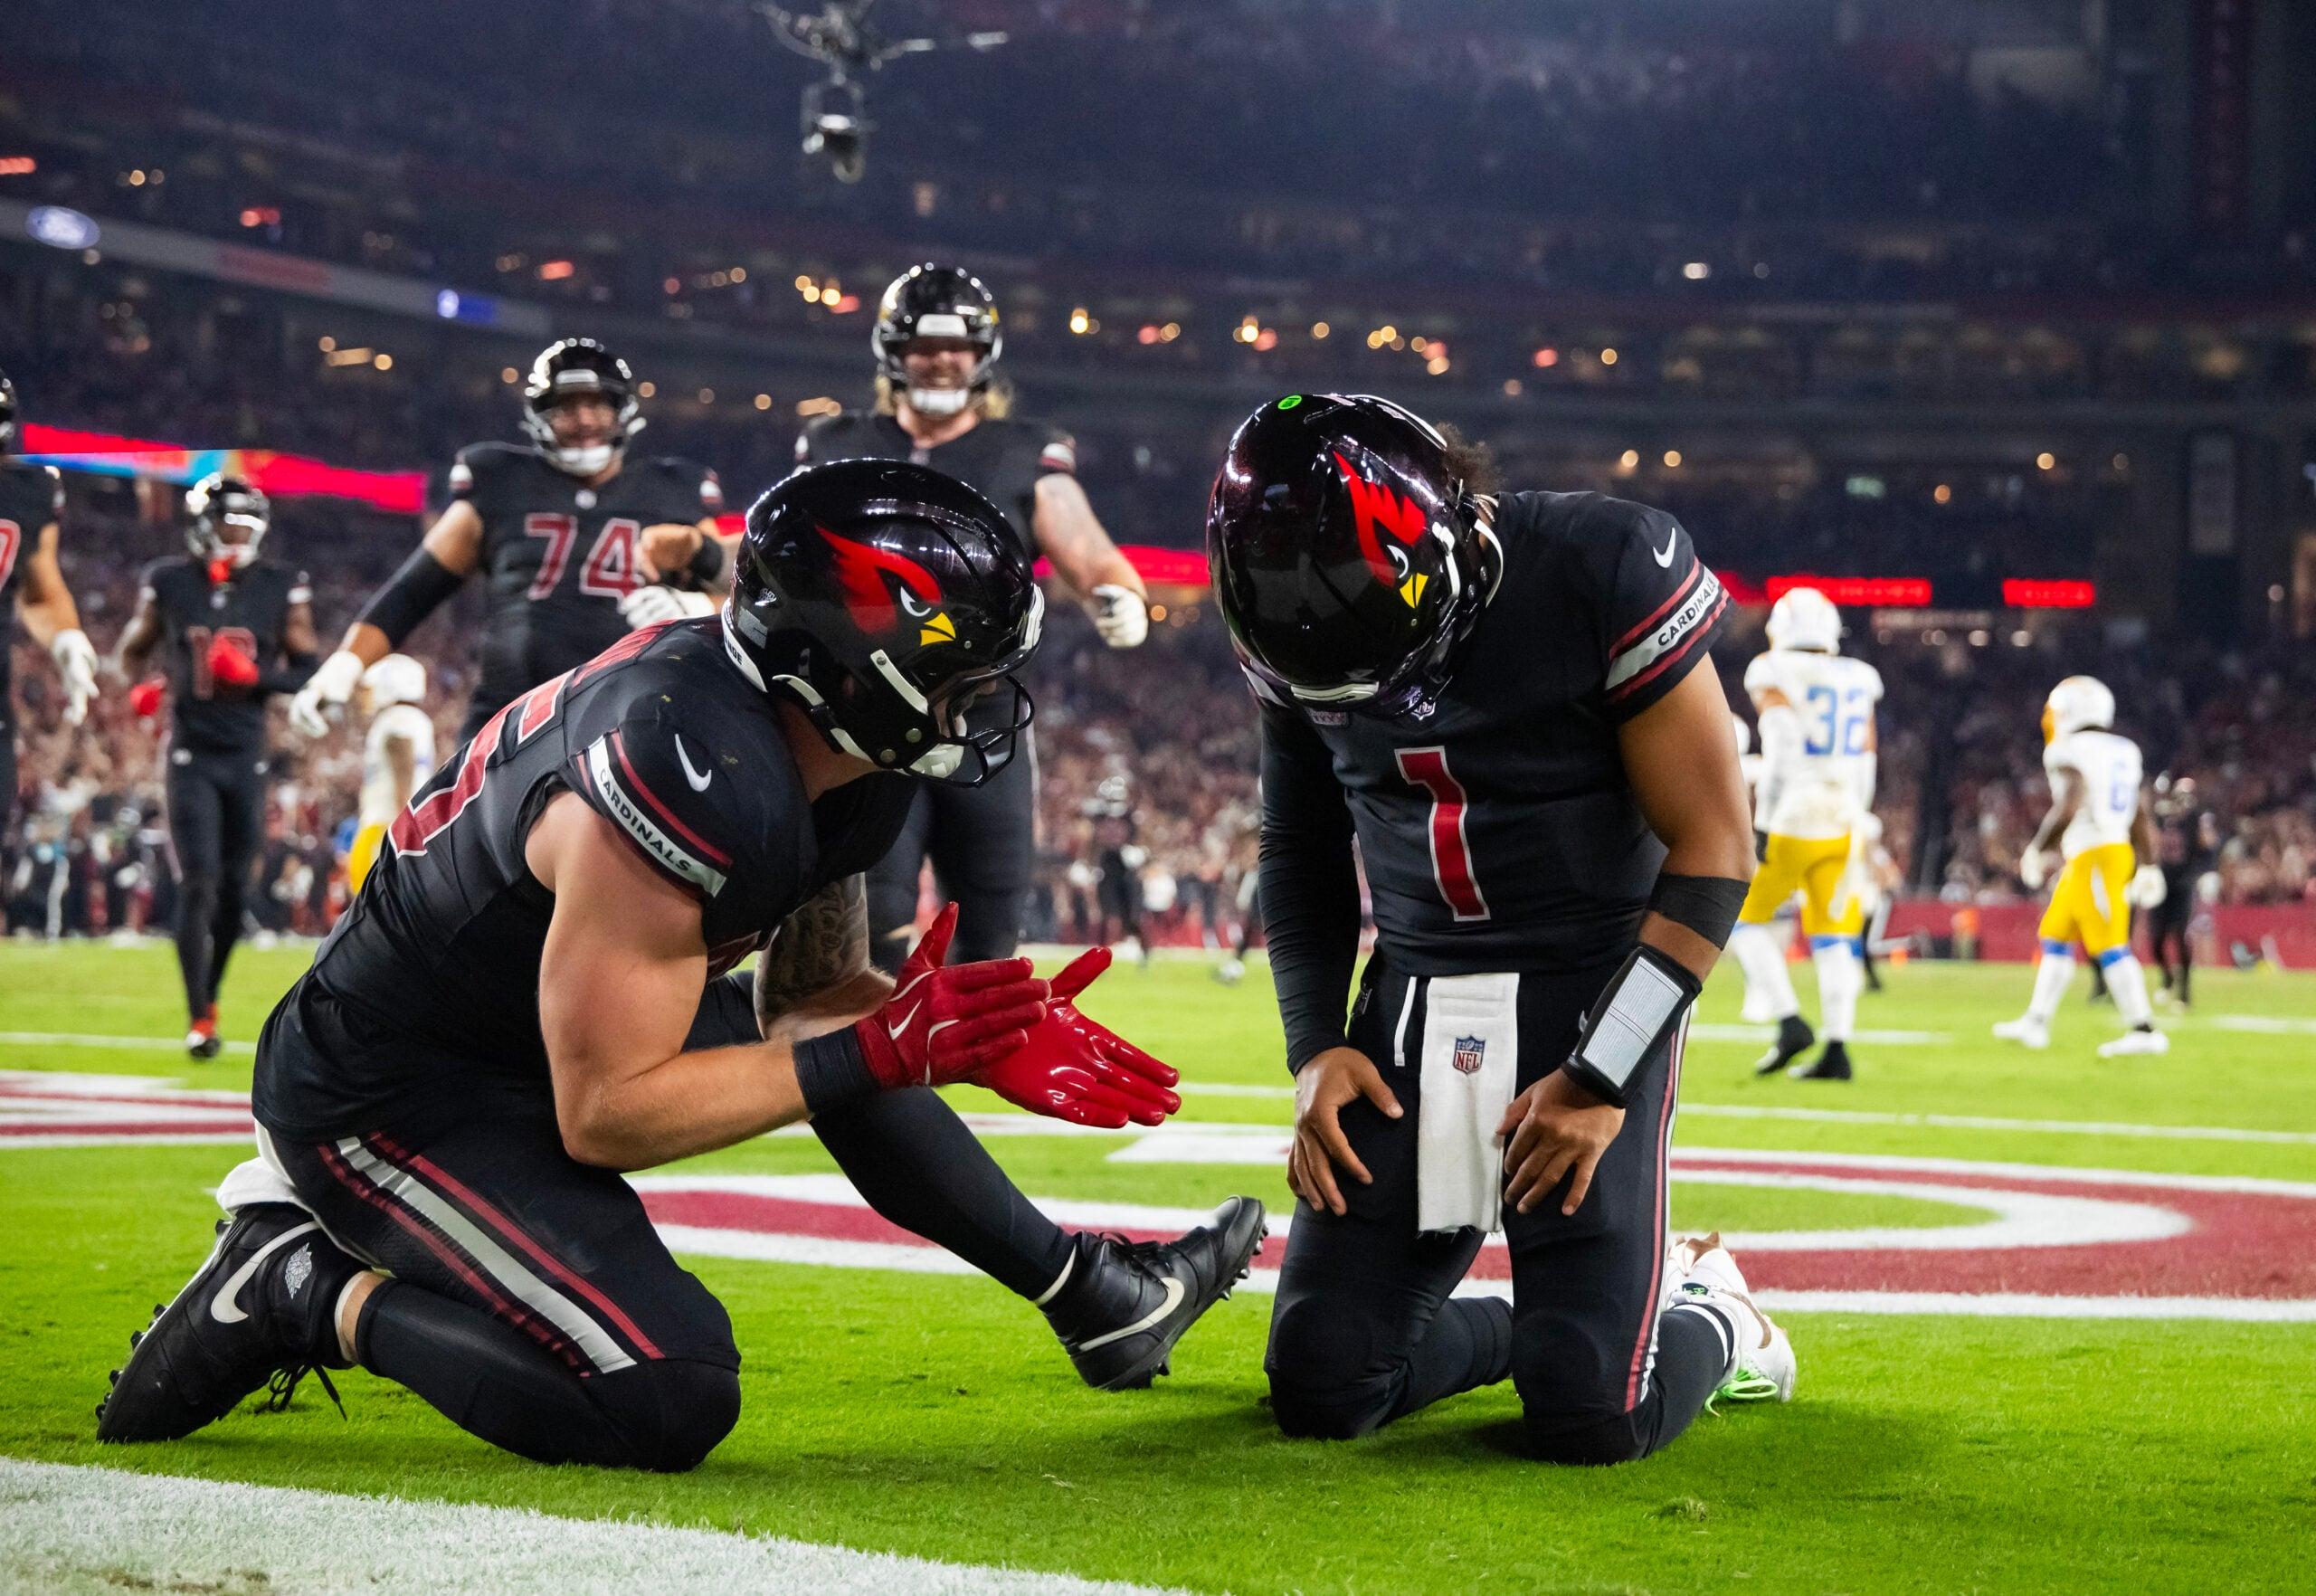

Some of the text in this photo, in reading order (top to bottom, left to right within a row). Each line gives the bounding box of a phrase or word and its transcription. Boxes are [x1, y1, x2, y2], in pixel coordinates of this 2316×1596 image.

[524, 512, 646, 615] 74
[1803, 683, 1867, 756] 32
[600, 768, 691, 871] CARDINALS
[1394, 746, 1492, 923] 1
[1455, 1050, 1481, 1071] NFL
